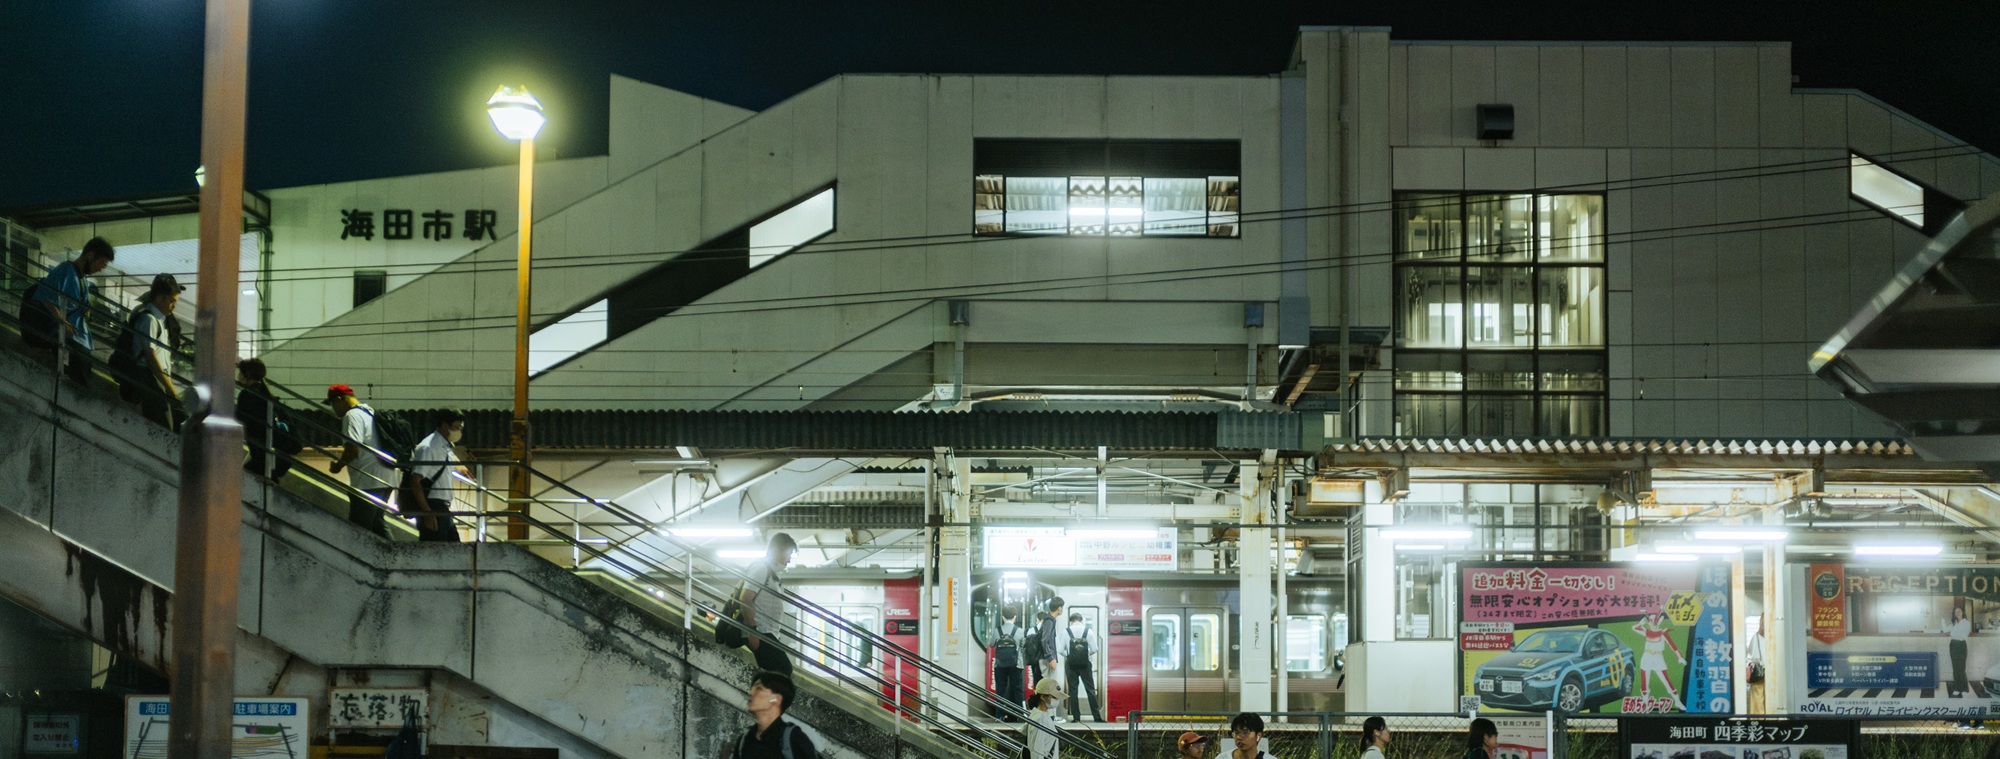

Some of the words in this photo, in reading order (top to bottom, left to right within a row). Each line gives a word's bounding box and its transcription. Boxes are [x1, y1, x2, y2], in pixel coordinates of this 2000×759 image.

[341, 209, 497, 241] 海田市駅
[1474, 569, 1613, 590] 追加料金一切なし!
[1470, 593, 1660, 608] 無限安心オプションが大好評!
[1704, 567, 1732, 713] ほめる教習の
[1801, 700, 1833, 712] ROYAL
[1668, 726, 1707, 739] 海田町
[1714, 724, 1808, 742] 四季彩マップ
